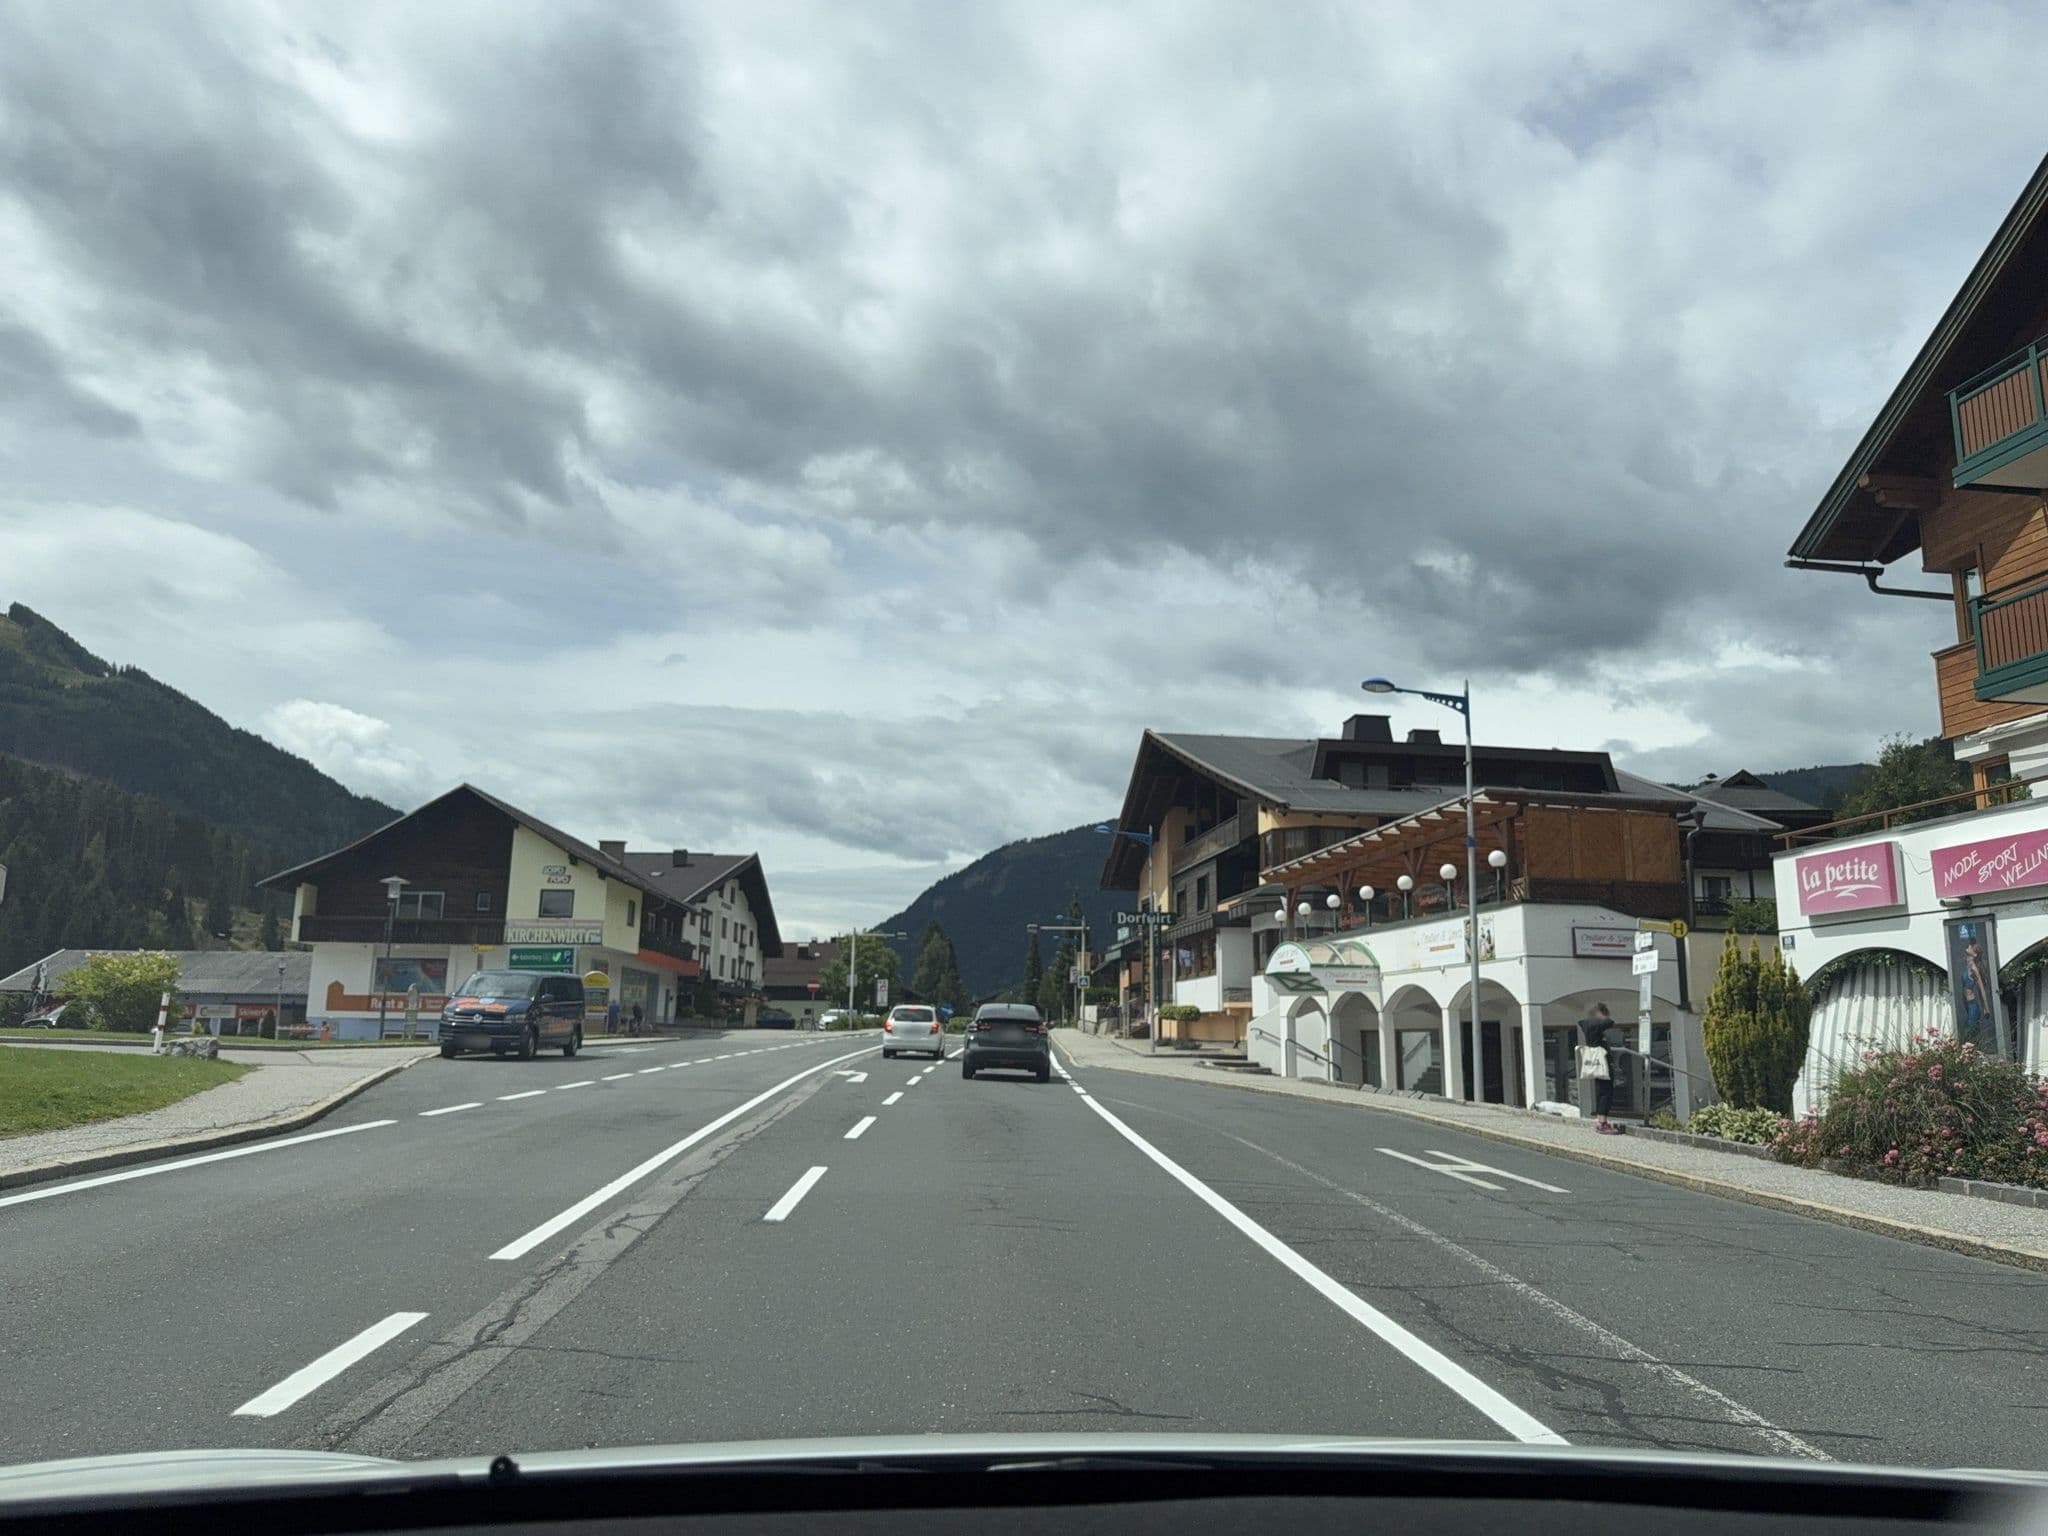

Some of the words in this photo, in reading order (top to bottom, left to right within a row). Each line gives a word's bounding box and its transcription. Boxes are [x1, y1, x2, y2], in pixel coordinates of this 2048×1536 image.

[1802, 866, 1821, 892] la
[1825, 857, 1879, 892] petite
[1943, 850, 1981, 887] MODE
[1978, 842, 2018, 883] SPORT
[507, 928, 585, 943] KIRCHENWIRT
[1674, 922, 1684, 935] H
